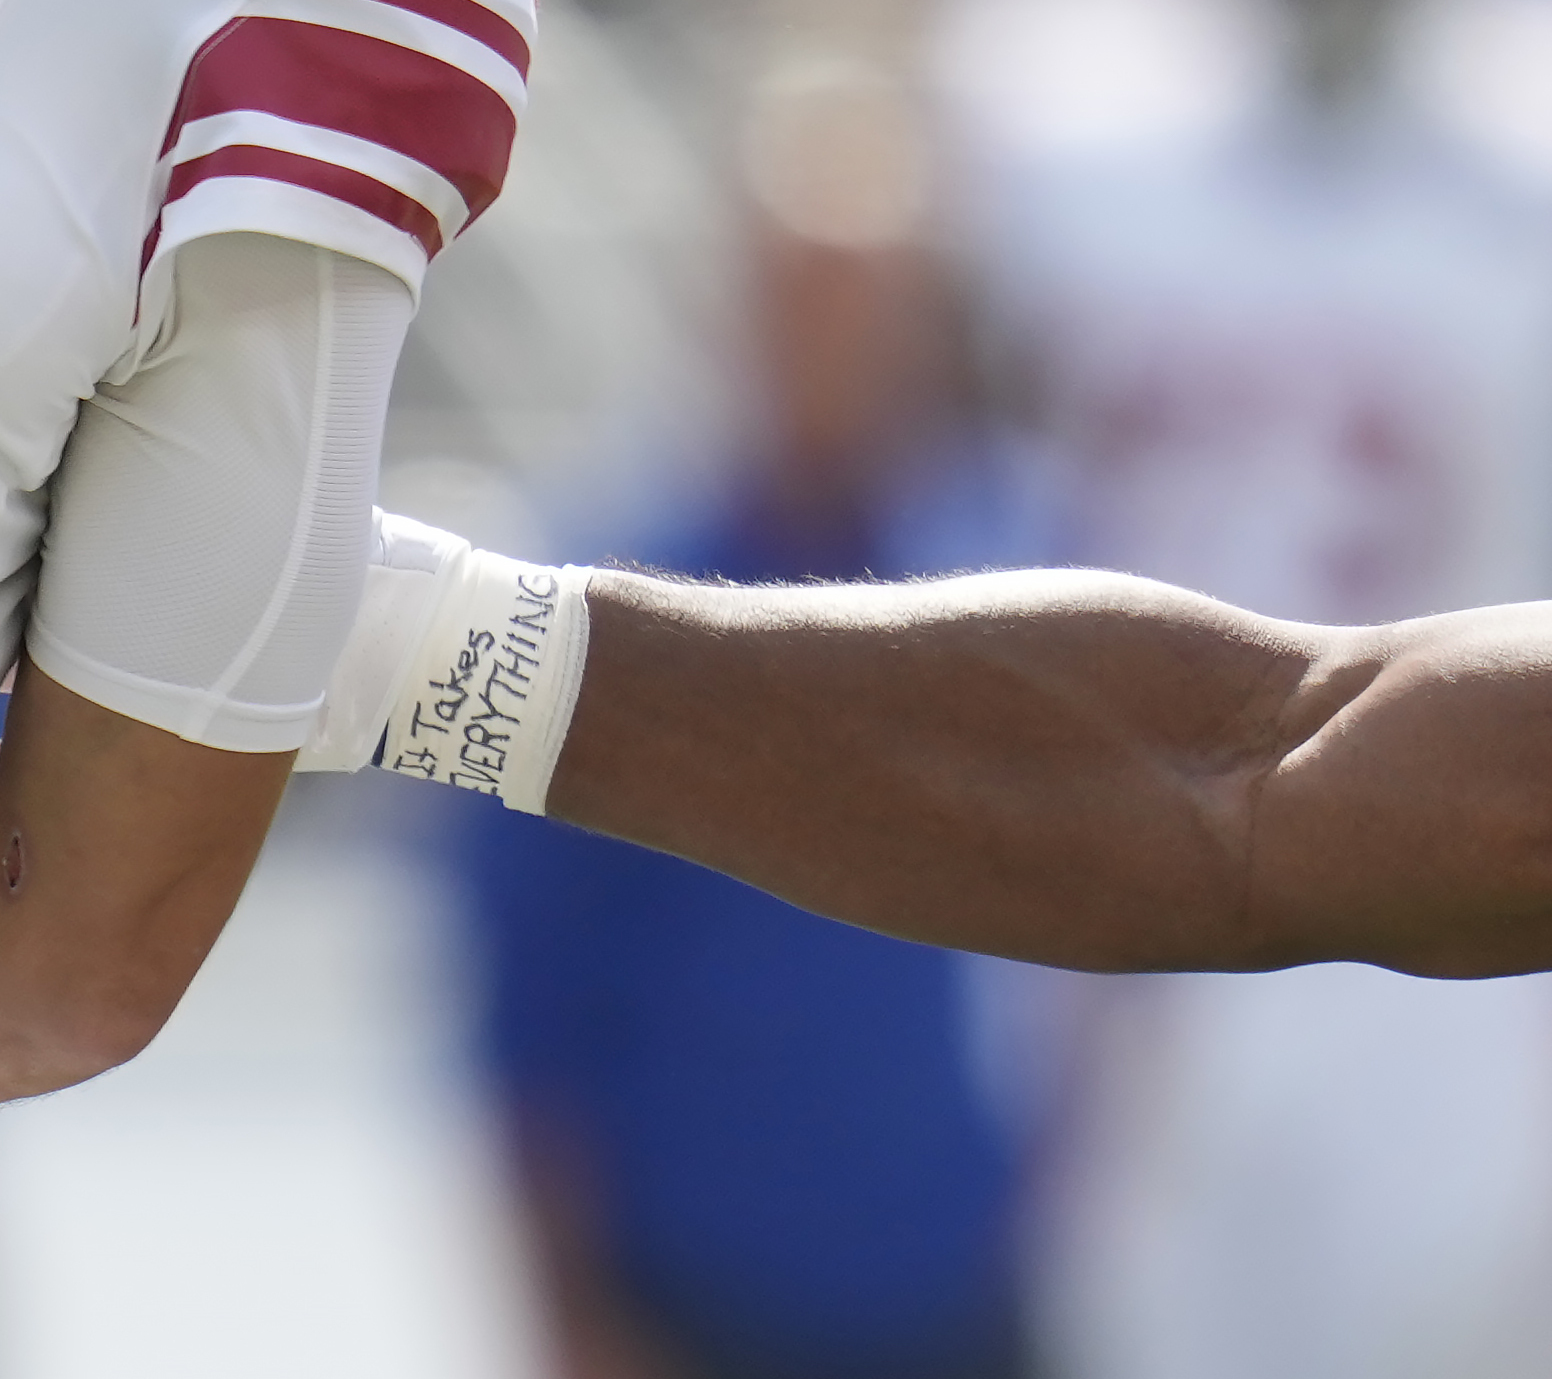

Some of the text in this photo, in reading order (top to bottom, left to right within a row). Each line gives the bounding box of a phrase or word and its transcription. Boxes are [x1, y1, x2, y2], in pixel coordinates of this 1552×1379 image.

[393, 628, 496, 777] It Takes
[449, 574, 558, 797] VERYTHING
